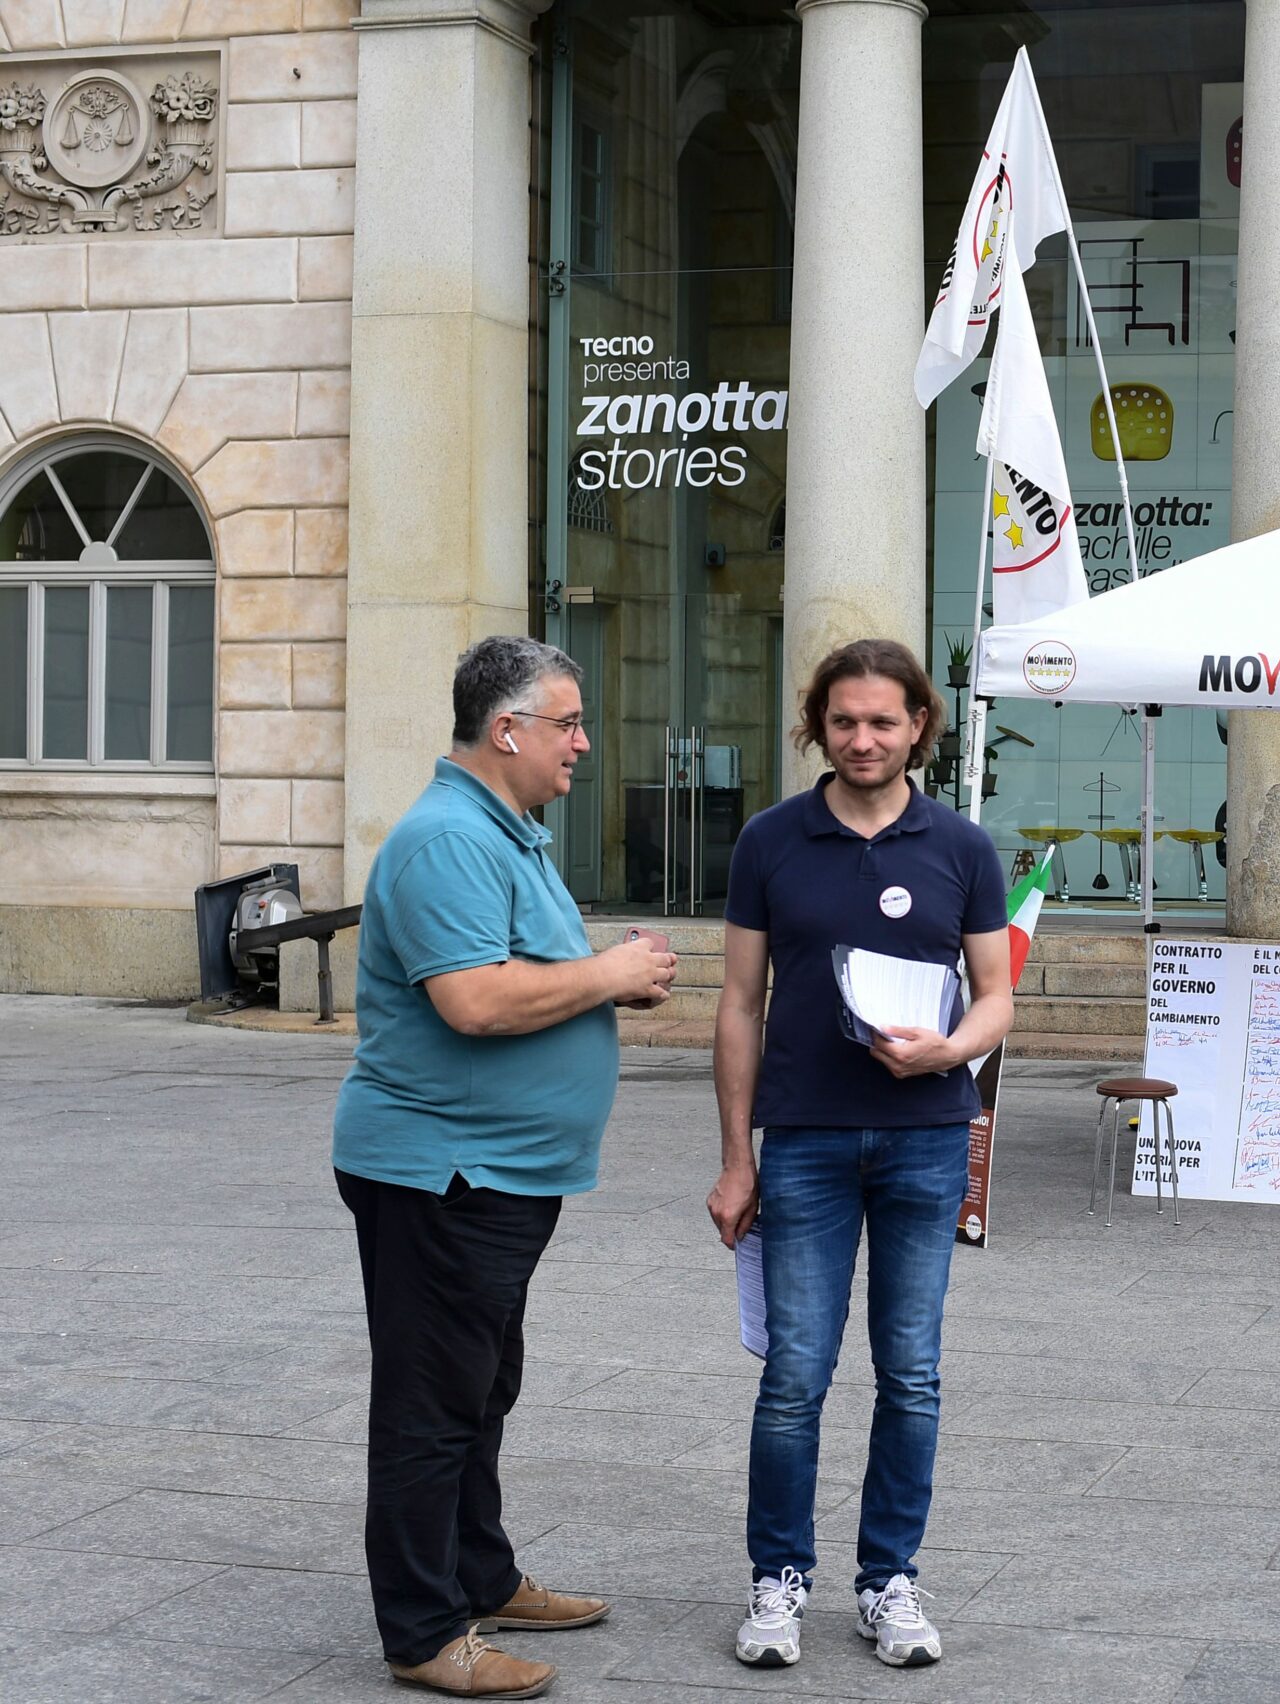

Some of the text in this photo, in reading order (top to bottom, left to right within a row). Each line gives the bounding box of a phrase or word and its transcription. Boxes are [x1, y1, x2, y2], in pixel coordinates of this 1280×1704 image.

[583, 356, 690, 388] presenta
[577, 433, 748, 490] stories
[1027, 652, 1073, 666] MOVIMENTO
[1154, 944, 1223, 959] CONTRATTO
[1263, 950, 1271, 960] IL
[1153, 961, 1189, 975] PER IL
[1253, 964, 1271, 974] DEL
[1152, 978, 1216, 994] GOVERNO
[1150, 997, 1168, 1008] DEL
[1149, 1011, 1220, 1026] CAMBIAMENTO
[1179, 1156, 1200, 1168] PER
